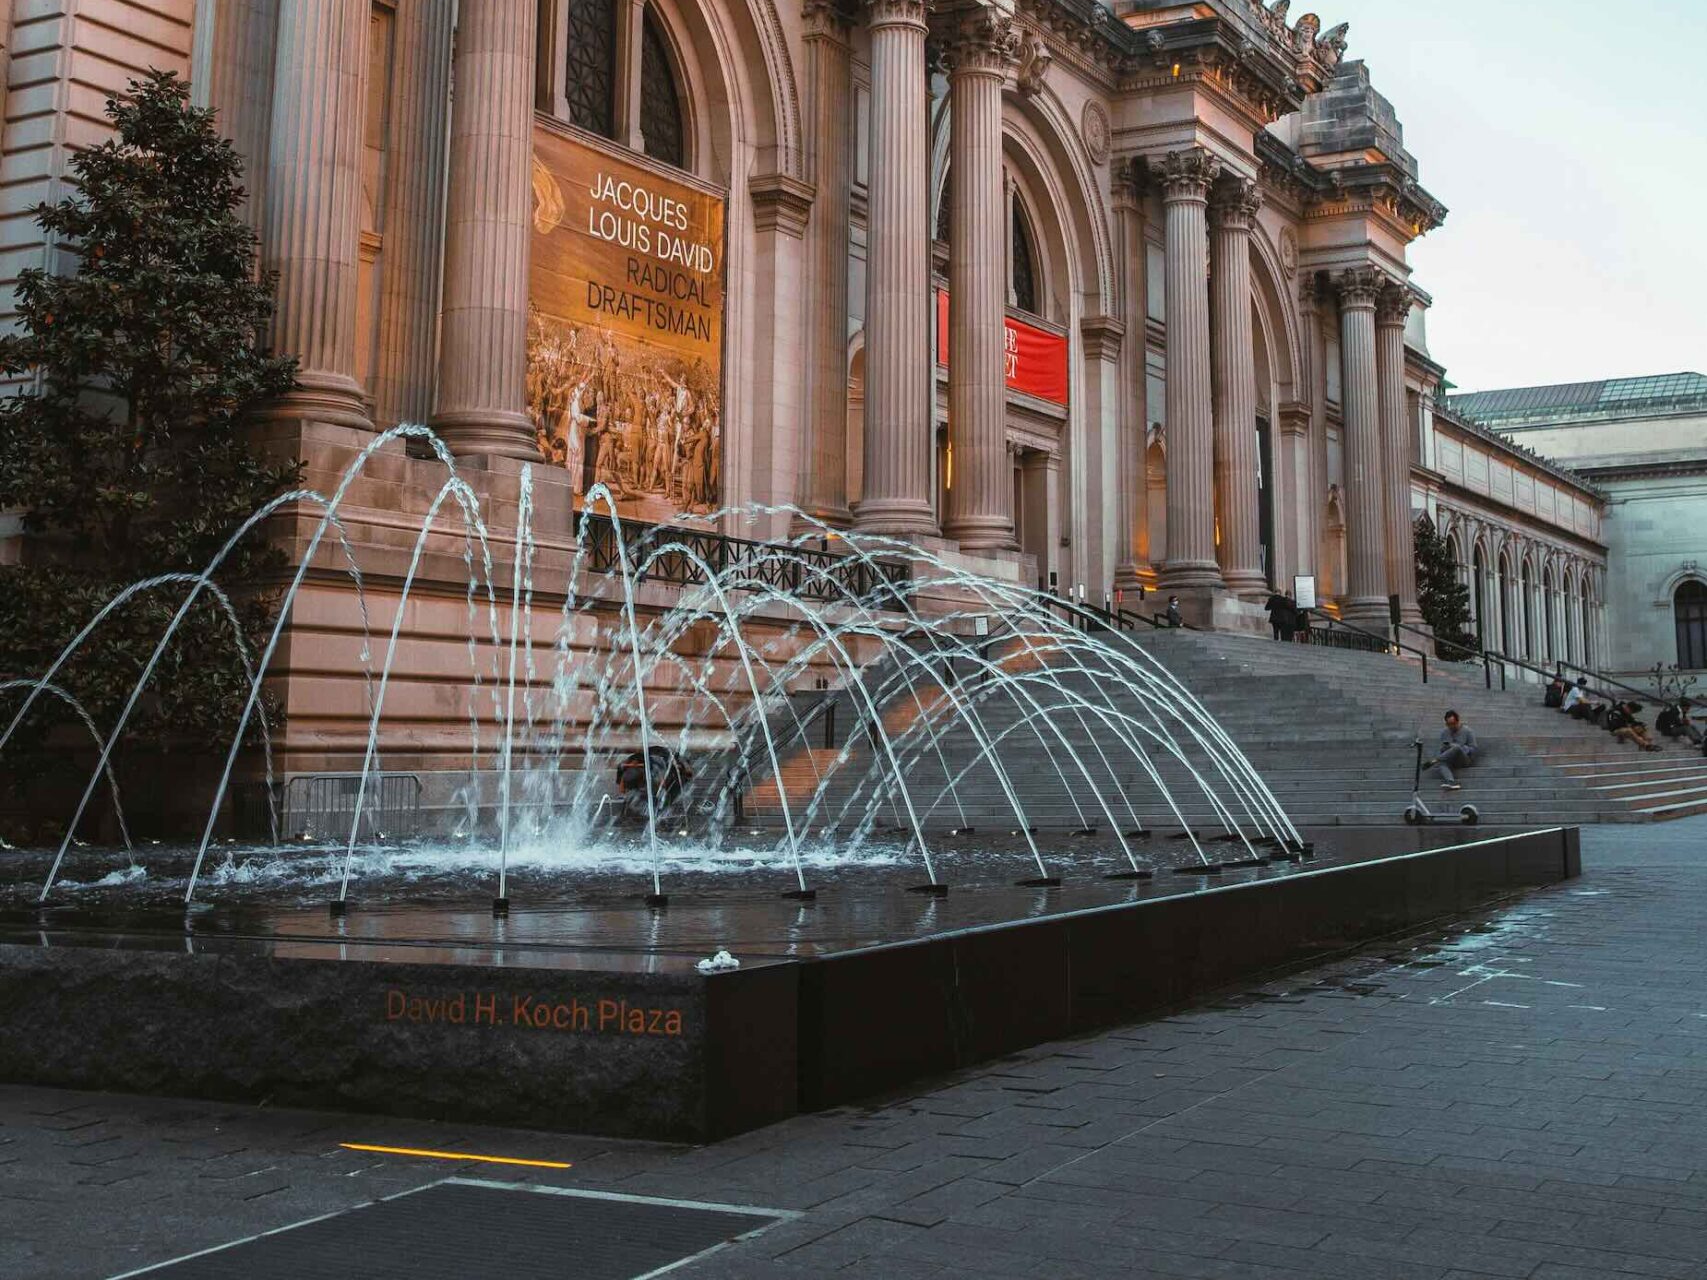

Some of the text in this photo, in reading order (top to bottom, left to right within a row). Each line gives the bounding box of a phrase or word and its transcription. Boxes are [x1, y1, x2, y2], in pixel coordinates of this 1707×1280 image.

[590, 173, 687, 230] JACQUES
[589, 207, 713, 273] LOUIS DAVID
[627, 258, 711, 308] RADICAL
[587, 281, 711, 342] DRAFTSMAN
[1004, 327, 1018, 353] HE
[1004, 353, 1018, 379] ET
[387, 990, 682, 1035] David H. Koch Plaza
